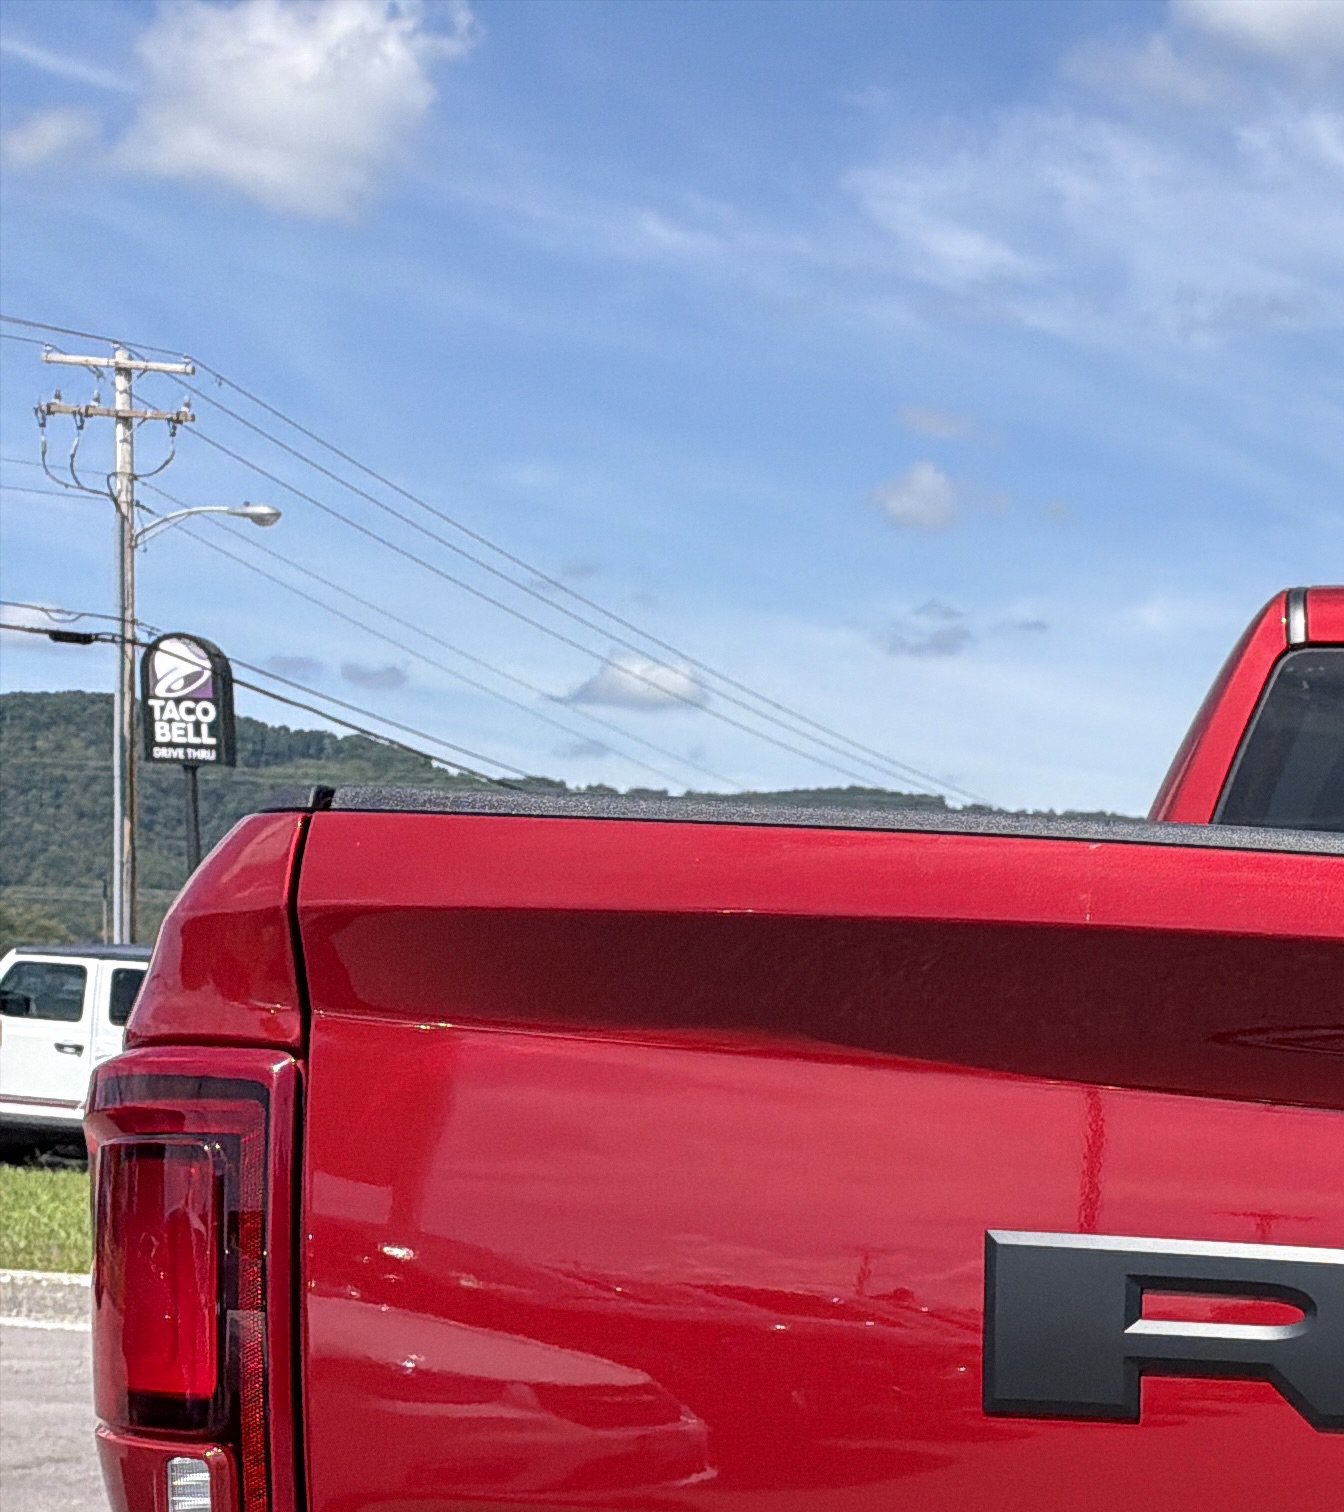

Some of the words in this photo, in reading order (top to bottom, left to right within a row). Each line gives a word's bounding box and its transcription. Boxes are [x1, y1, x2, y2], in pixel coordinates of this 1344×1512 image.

[148, 699, 216, 723] TACO
[154, 721, 217, 745] BELL
[152, 747, 184, 760] DRIVE
[187, 747, 216, 760] THRU
